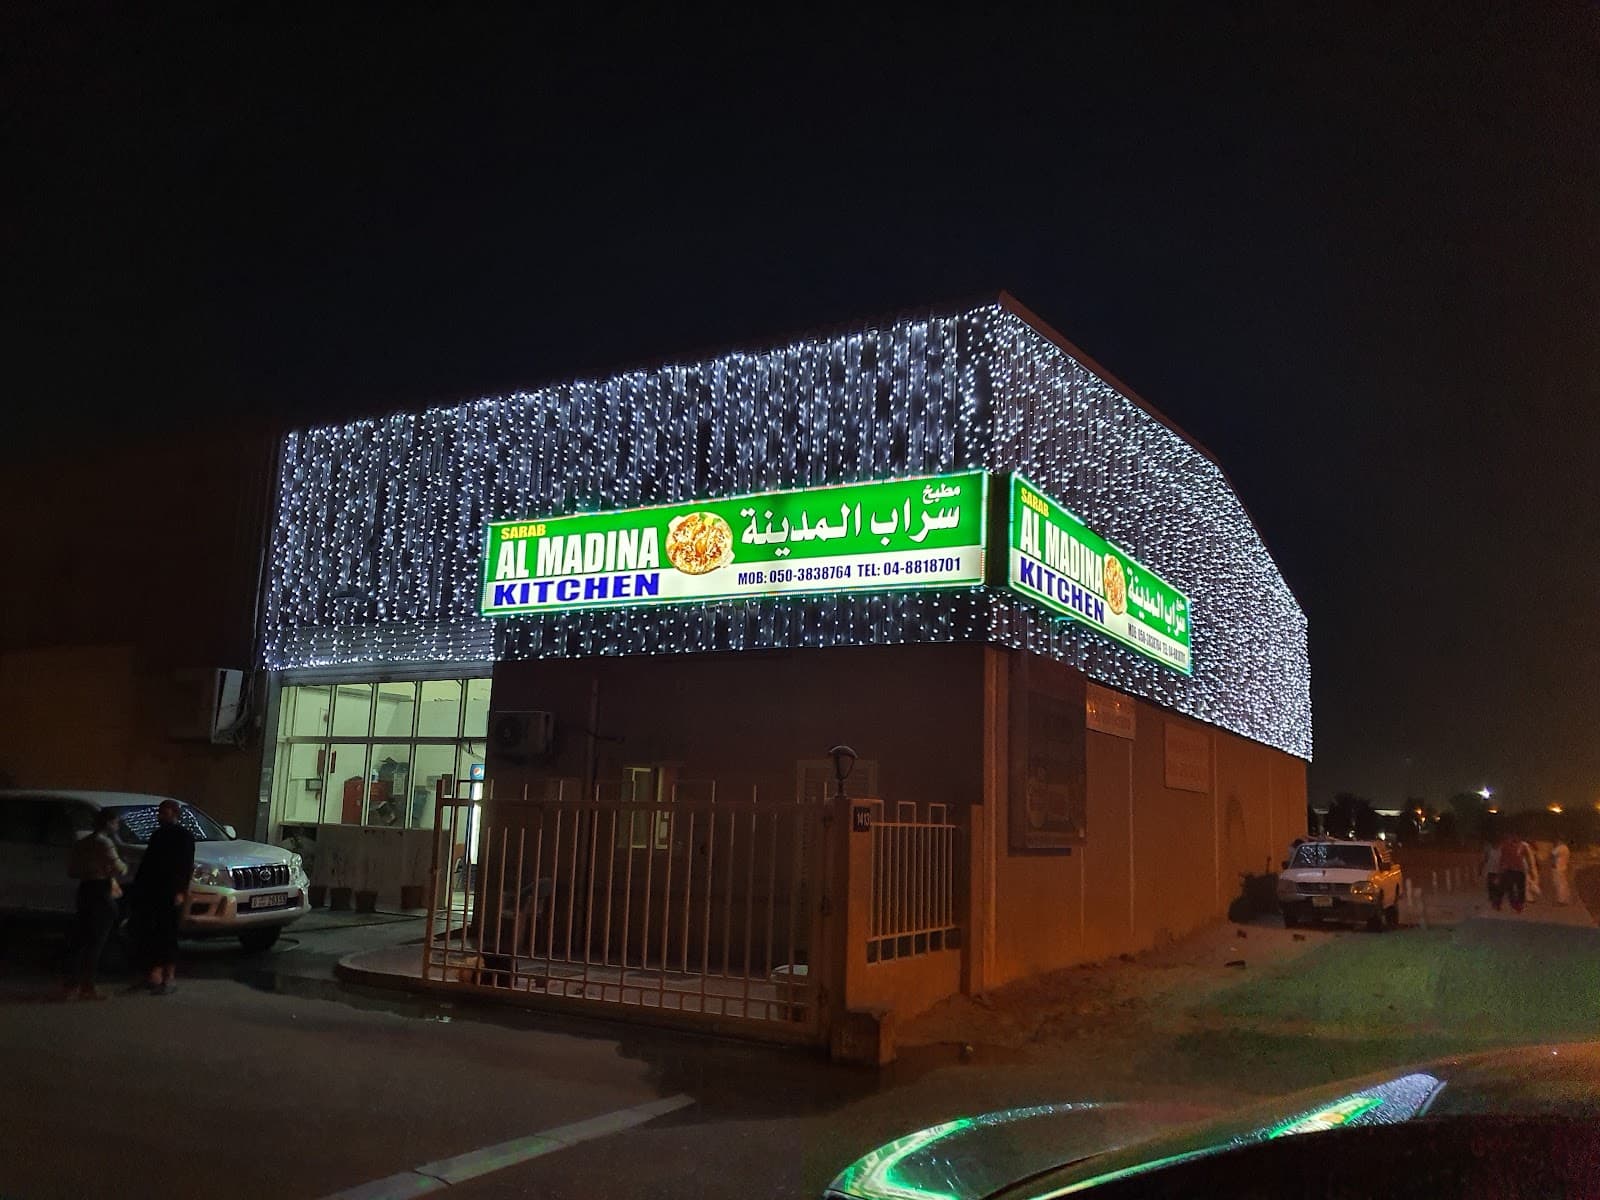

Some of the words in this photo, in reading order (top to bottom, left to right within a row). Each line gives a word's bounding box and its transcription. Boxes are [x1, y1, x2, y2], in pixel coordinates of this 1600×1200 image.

[922, 483, 961, 504] مطبخ
[1020, 487, 1049, 518] SARAB
[501, 524, 546, 540] SARAB
[740, 501, 862, 557] المدينة
[871, 497, 961, 546] سراب
[495, 539, 529, 580] AL
[536, 527, 660, 577] MADINA
[738, 570, 767, 585] MOB:
[769, 564, 851, 583] 050-3838764
[858, 562, 881, 577] TEL:
[883, 557, 961, 576] 04-8818701
[1020, 505, 1042, 561] AL
[1045, 519, 1104, 598] MADINA
[493, 573, 660, 606] KITCHEN
[1020, 556, 1104, 624] KITCHEN
